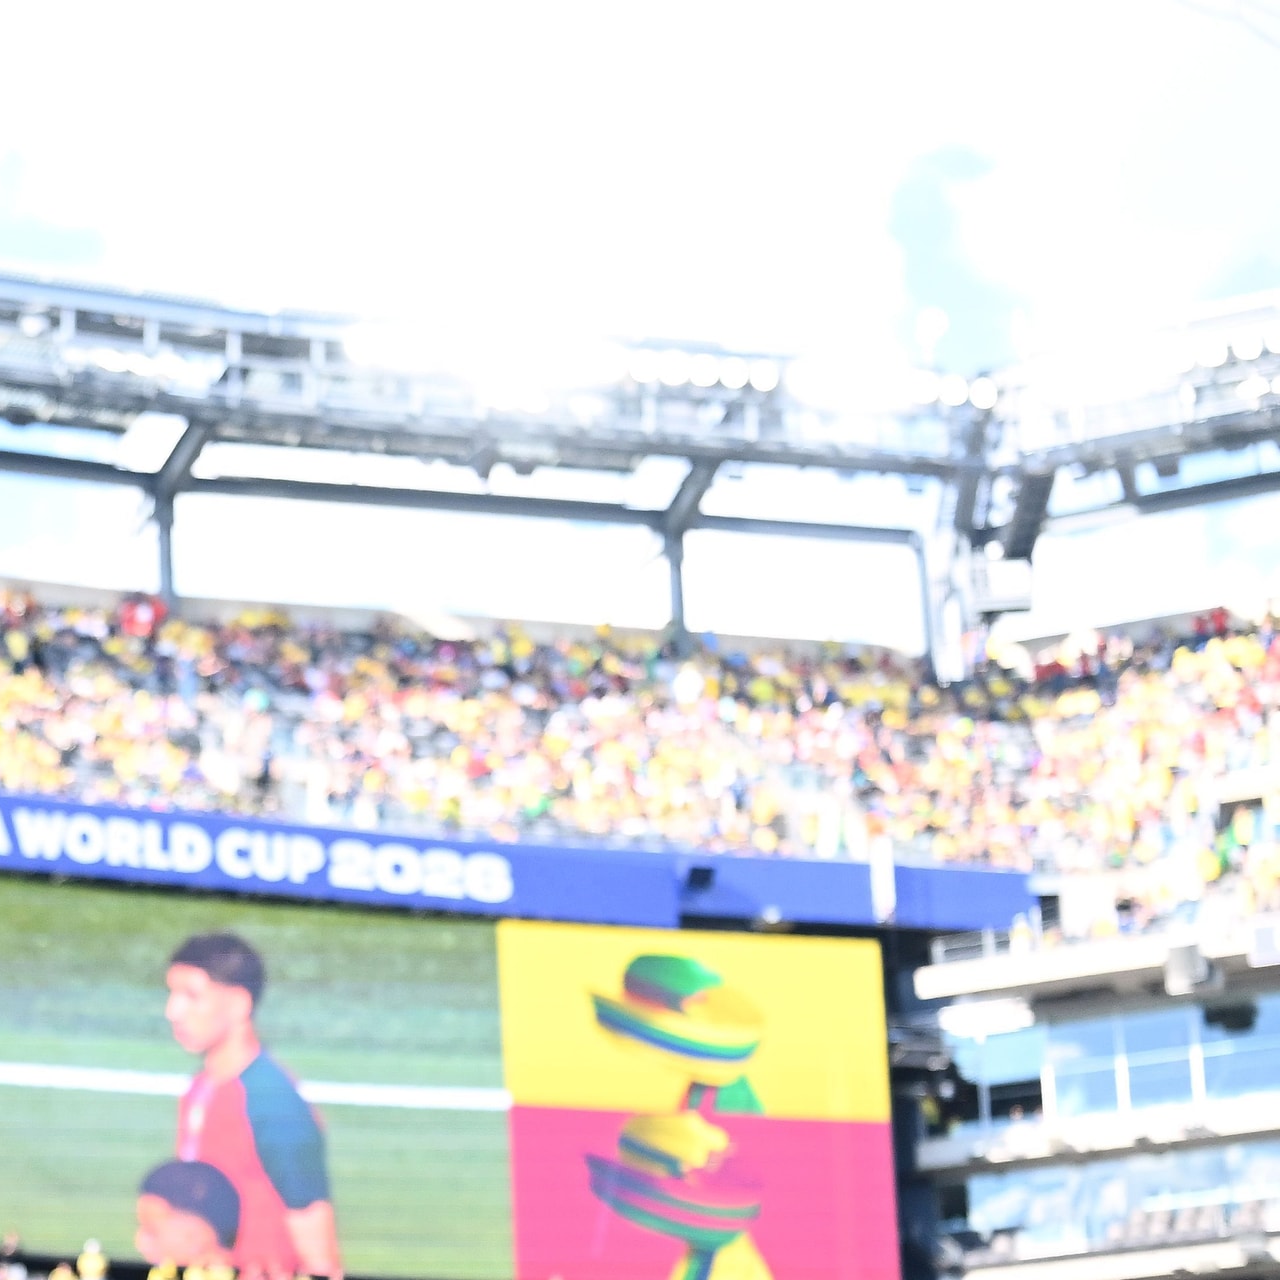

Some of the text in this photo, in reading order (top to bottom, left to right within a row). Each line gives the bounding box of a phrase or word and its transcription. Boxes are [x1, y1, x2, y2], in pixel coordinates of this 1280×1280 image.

[13, 808, 213, 875] WORLD
[215, 827, 326, 885] CUP
[328, 840, 515, 903] 2026
